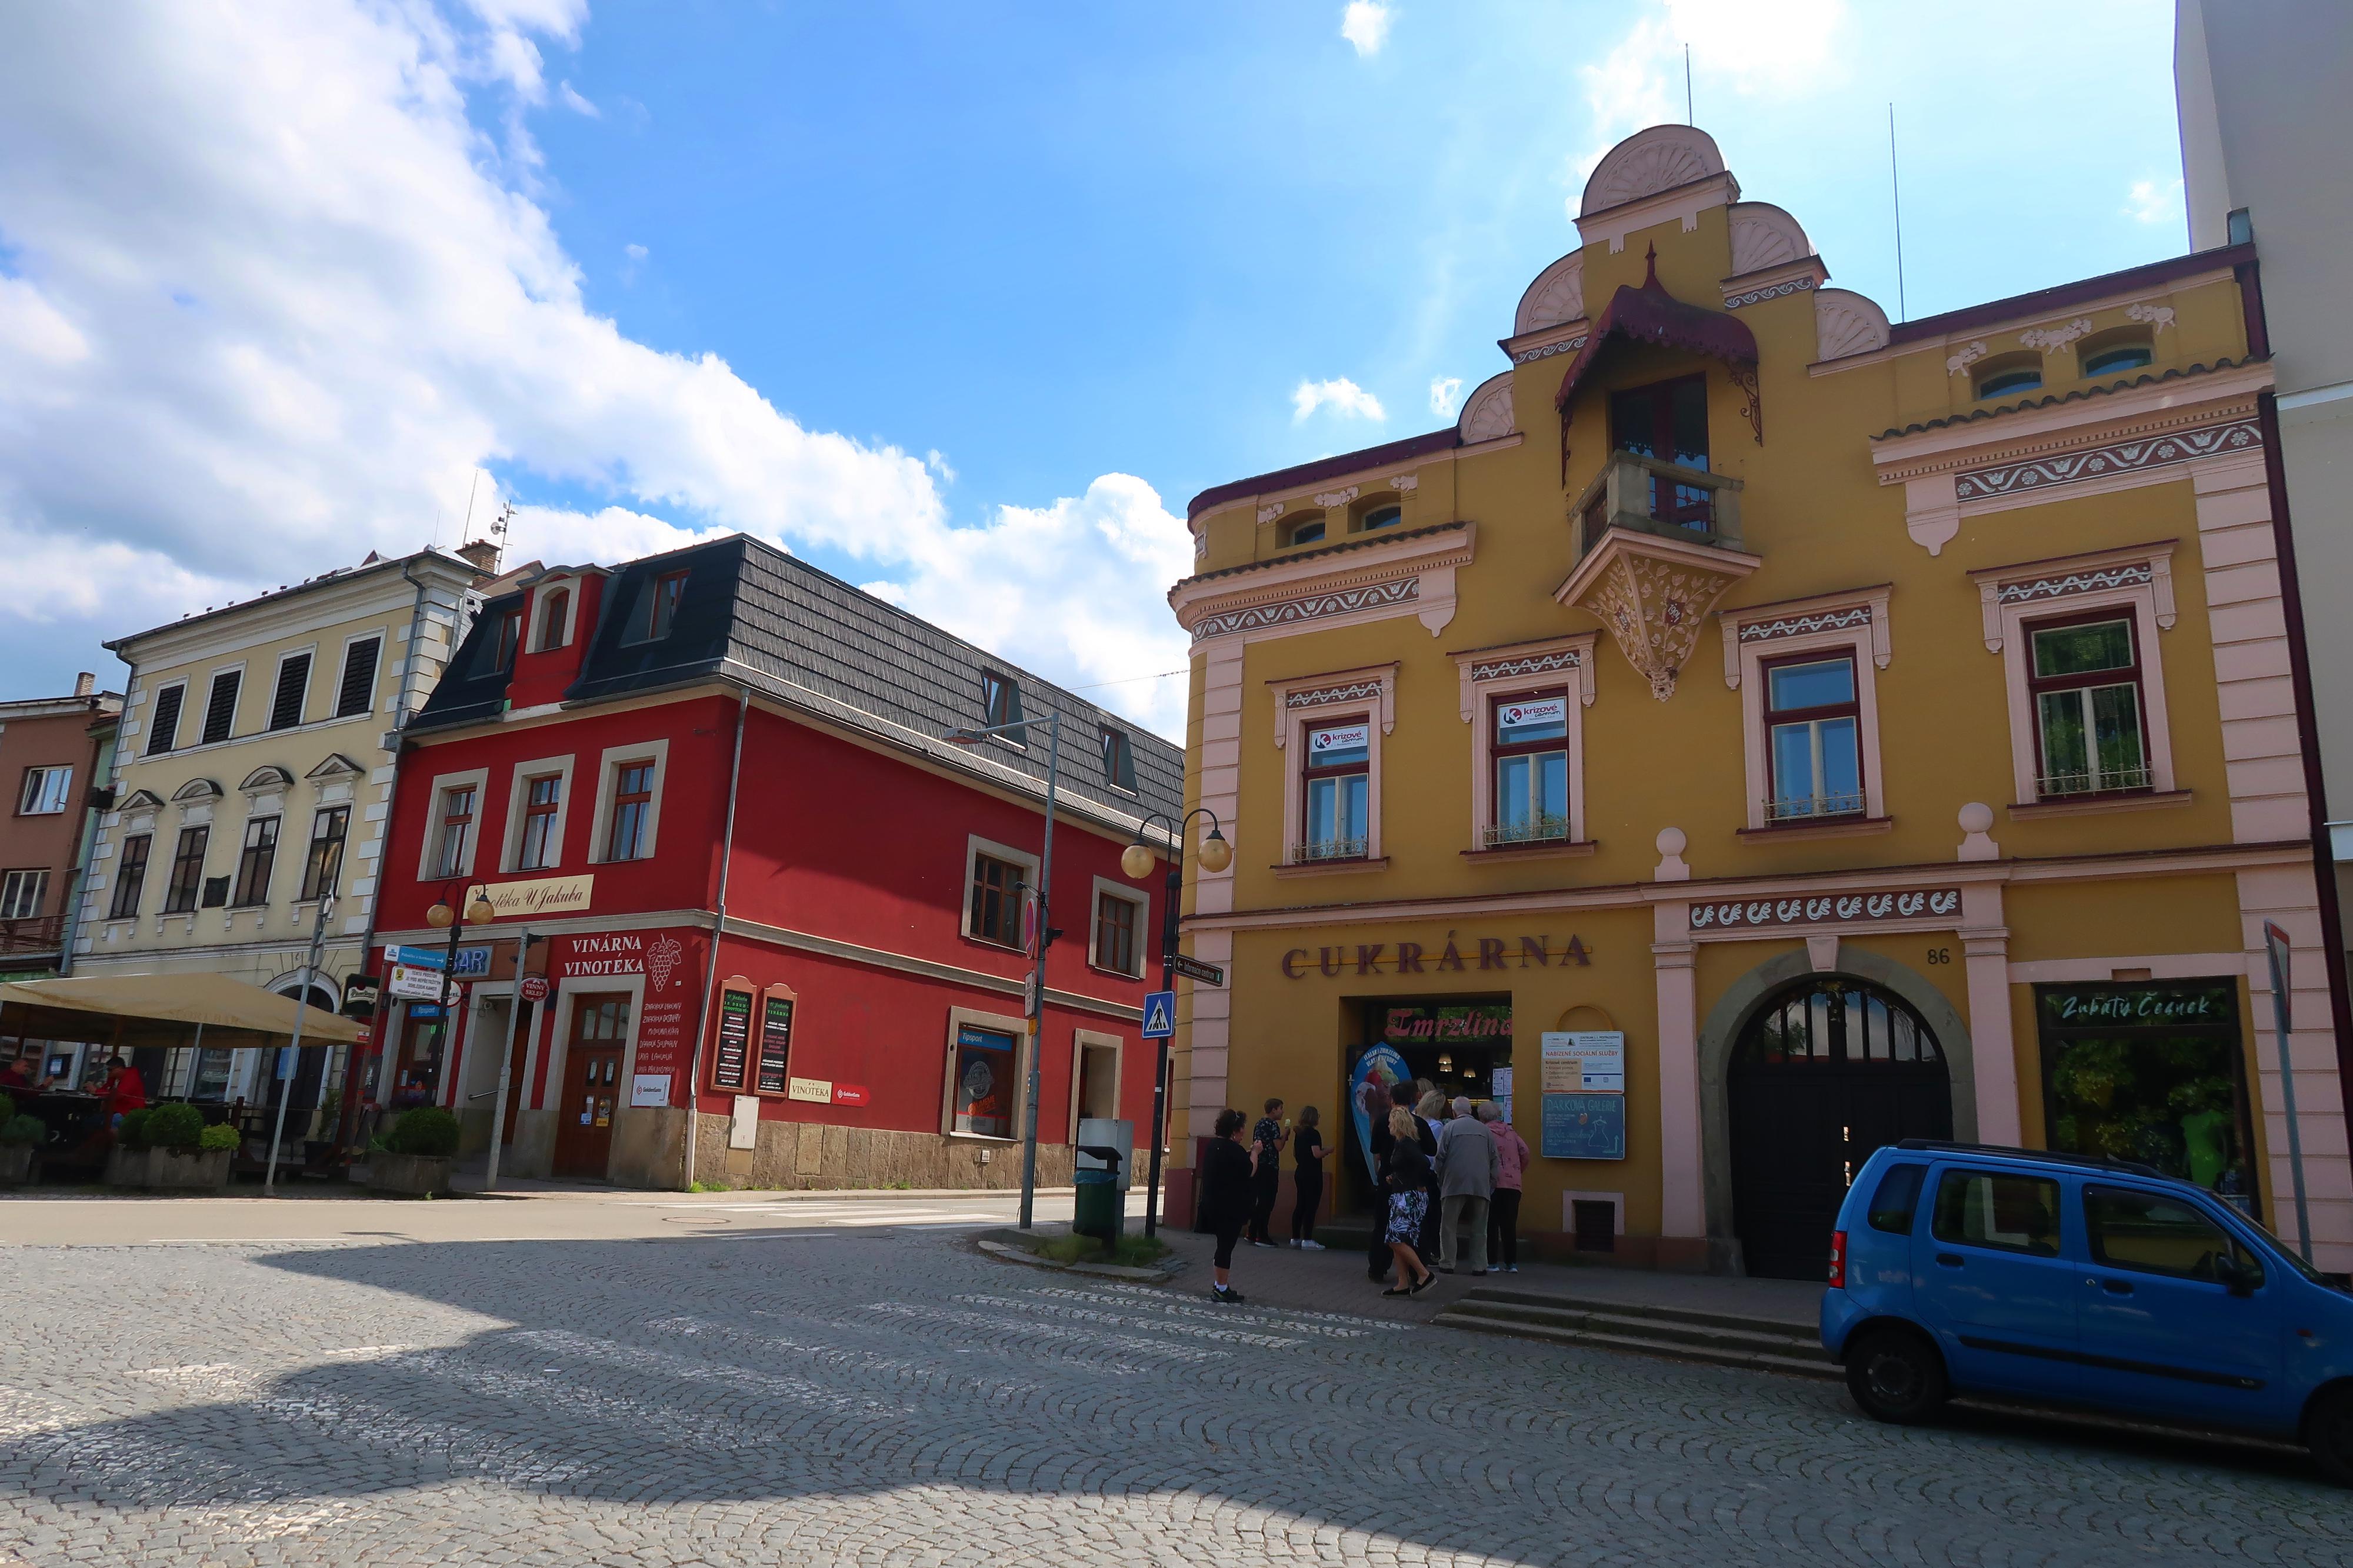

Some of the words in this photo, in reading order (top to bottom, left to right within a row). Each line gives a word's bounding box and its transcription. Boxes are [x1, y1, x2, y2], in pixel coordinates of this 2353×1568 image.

[1524, 703, 1558, 715] krizové
[1332, 730, 1362, 740] krizové
[472, 888, 521, 909] Votéka
[524, 887, 539, 906] U
[534, 883, 584, 912] Jakuba
[572, 933, 642, 953] VINÁRNA
[1281, 929, 1591, 980] CUKRÁRNA
[1927, 948, 1949, 965] 86
[564, 953, 645, 976] VINOTÉKA
[962, 1032, 983, 1043] Tipsport
[792, 1085, 829, 1097] VINOTÉKA
